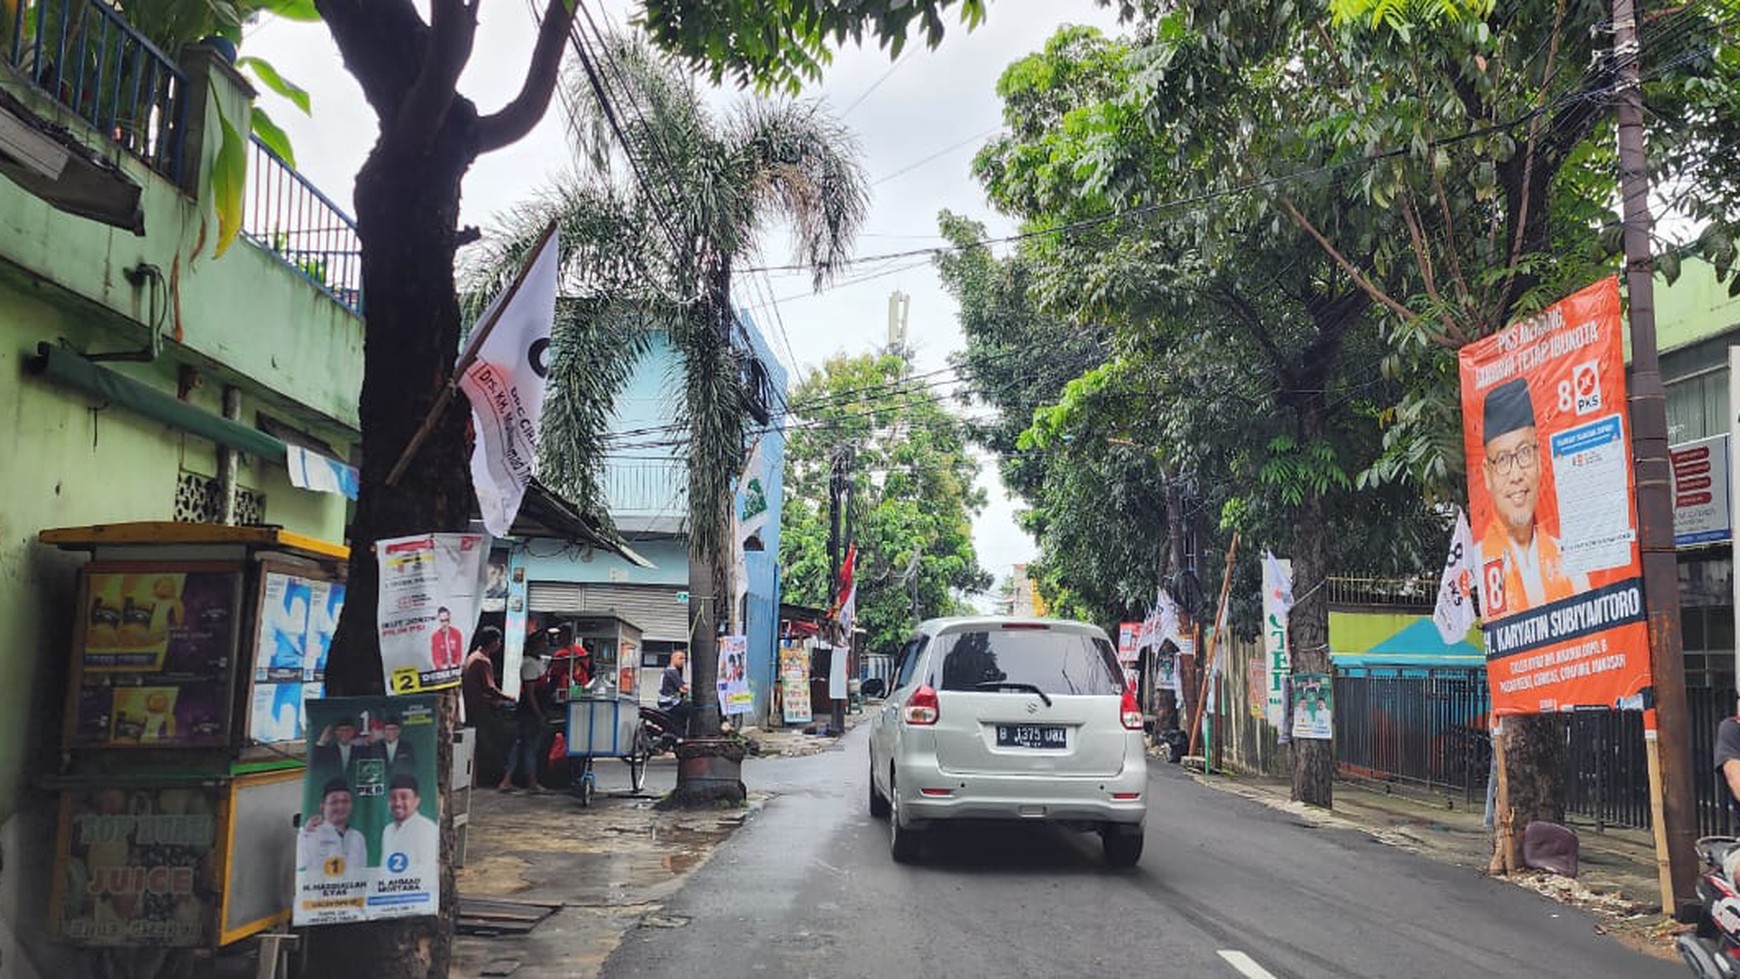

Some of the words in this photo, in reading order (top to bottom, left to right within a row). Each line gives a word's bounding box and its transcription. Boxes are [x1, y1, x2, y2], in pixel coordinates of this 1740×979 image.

[1550, 321, 1599, 358] IBUKOTA
[478, 369, 497, 394] Drs.
[494, 391, 509, 414] KH.
[1558, 380, 1573, 412] 8
[1577, 395, 1599, 413] PKS
[1447, 542, 1463, 568] 8
[1488, 566, 1503, 610] 8
[1497, 612, 1549, 652] KARYATIN
[1550, 588, 1640, 637] SUBIYANTORO
[399, 674, 415, 691] 2
[359, 710, 370, 736] 1
[1000, 727, 1008, 740] B
[87, 865, 194, 895] JUICE
